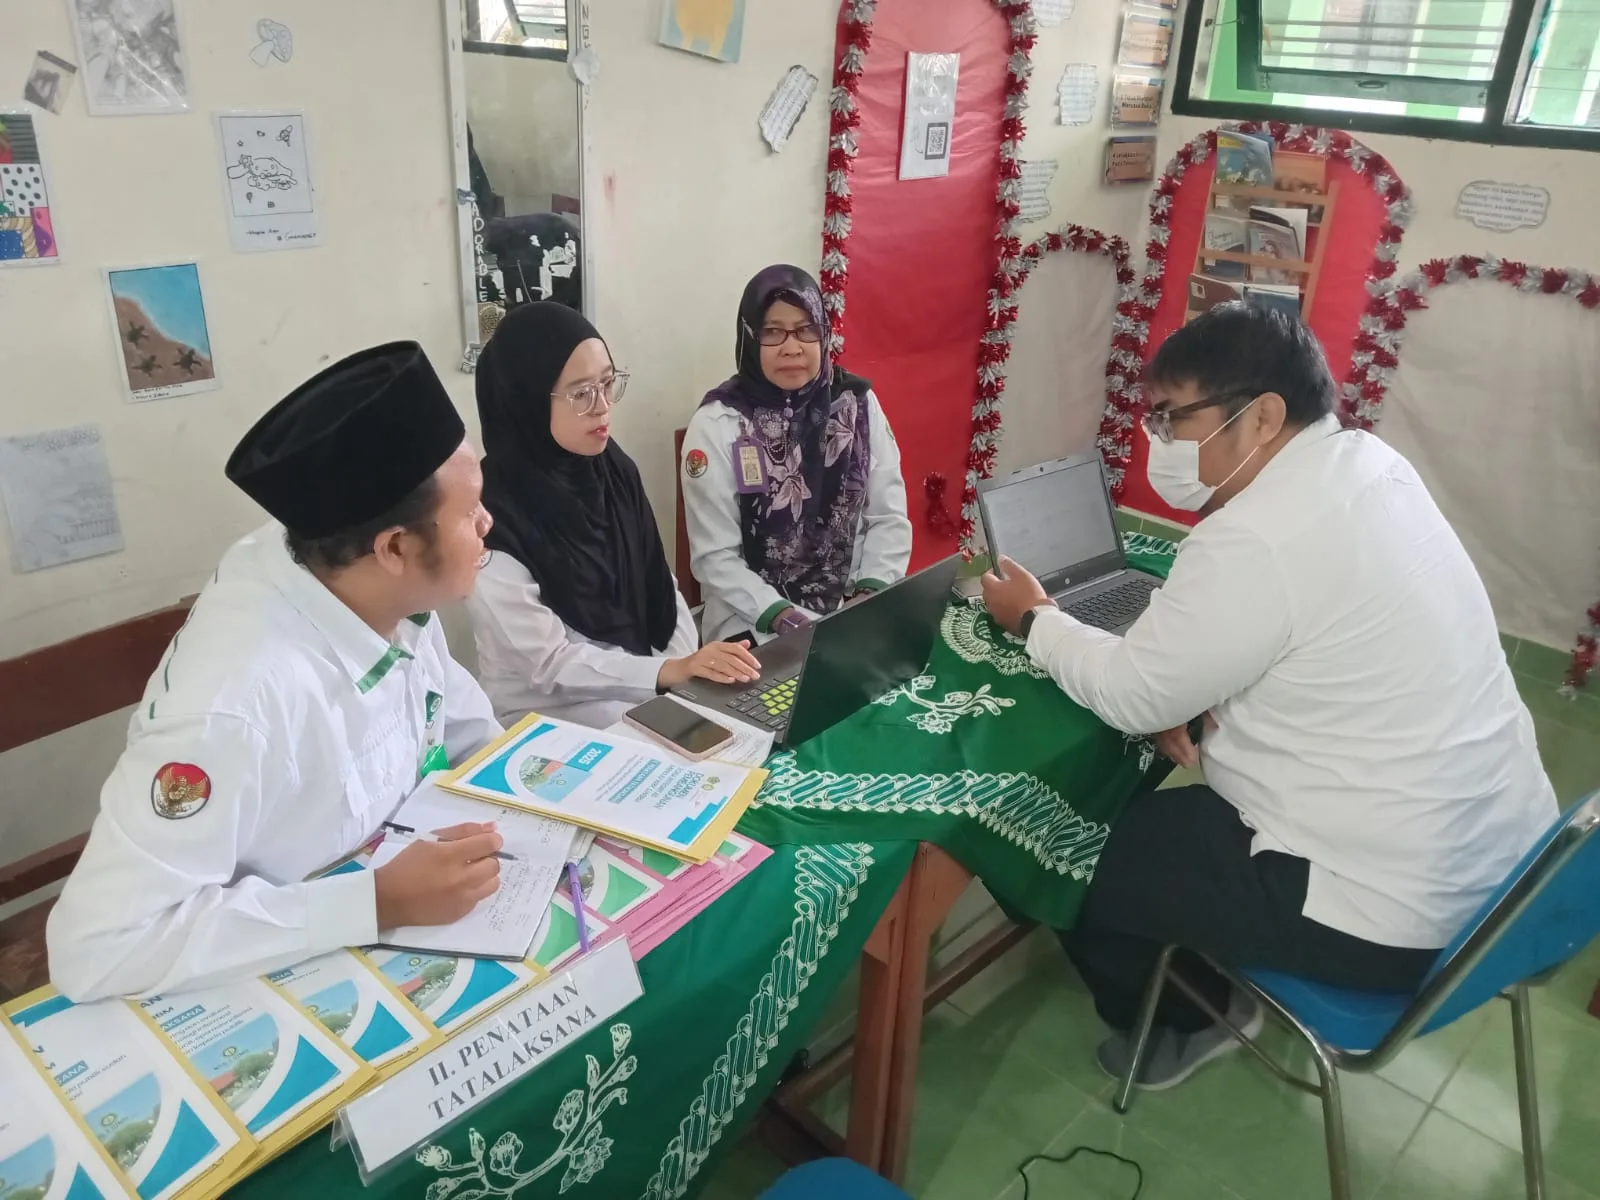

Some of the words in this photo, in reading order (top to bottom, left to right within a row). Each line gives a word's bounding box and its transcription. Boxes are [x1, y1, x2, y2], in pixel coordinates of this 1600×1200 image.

[472, 202, 488, 302] ADORABLE
[578, 748, 602, 765] 2025
[428, 1061, 456, 1087] II.
[458, 980, 580, 1069] PENATAAN
[428, 1005, 597, 1120] TATALAKSANA
